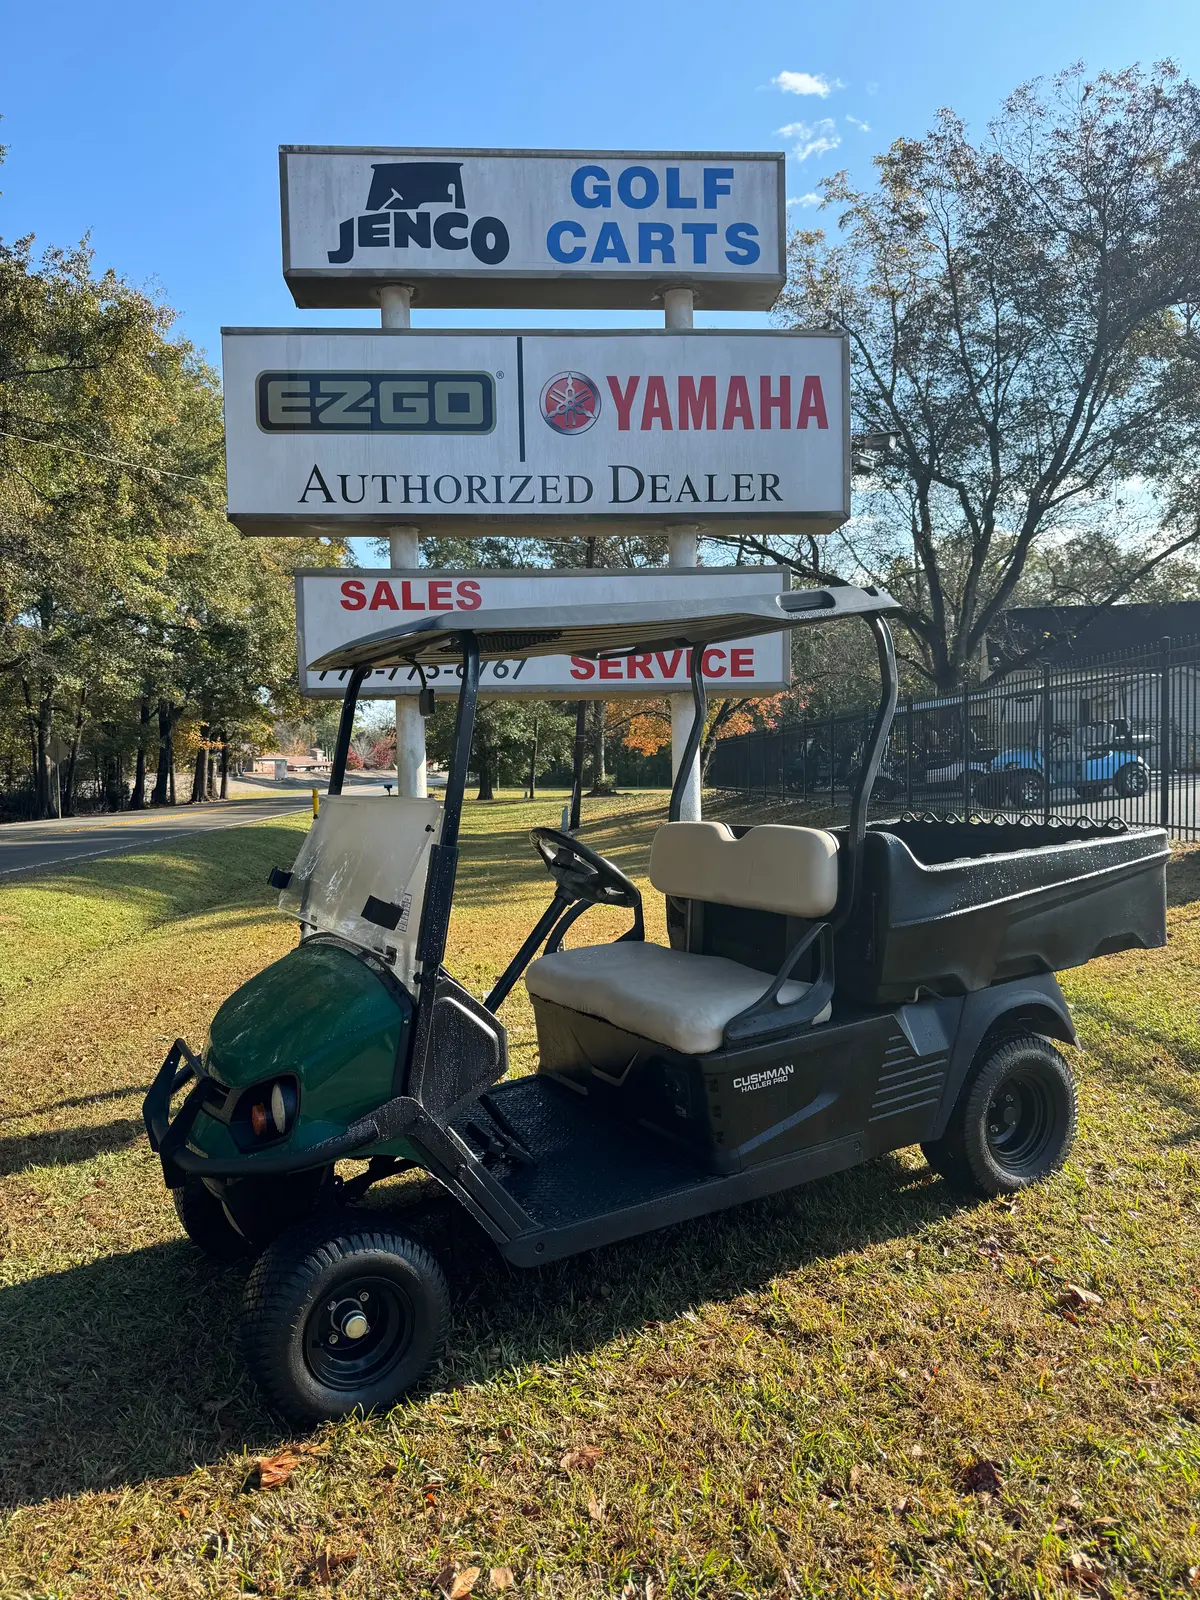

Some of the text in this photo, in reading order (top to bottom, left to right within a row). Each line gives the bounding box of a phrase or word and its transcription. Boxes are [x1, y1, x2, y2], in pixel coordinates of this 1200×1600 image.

[570, 165, 734, 210] GOLF
[327, 212, 510, 265] JENCO
[546, 221, 761, 266] CARTS
[267, 380, 483, 425] EZGO
[606, 375, 829, 431] YAMAHA
[298, 464, 784, 504] AUTHORIZED DEALER
[340, 580, 482, 611] SALES
[733, 1064, 794, 1088] CUSHMAN
[741, 1075, 788, 1093] HAULER PRO
